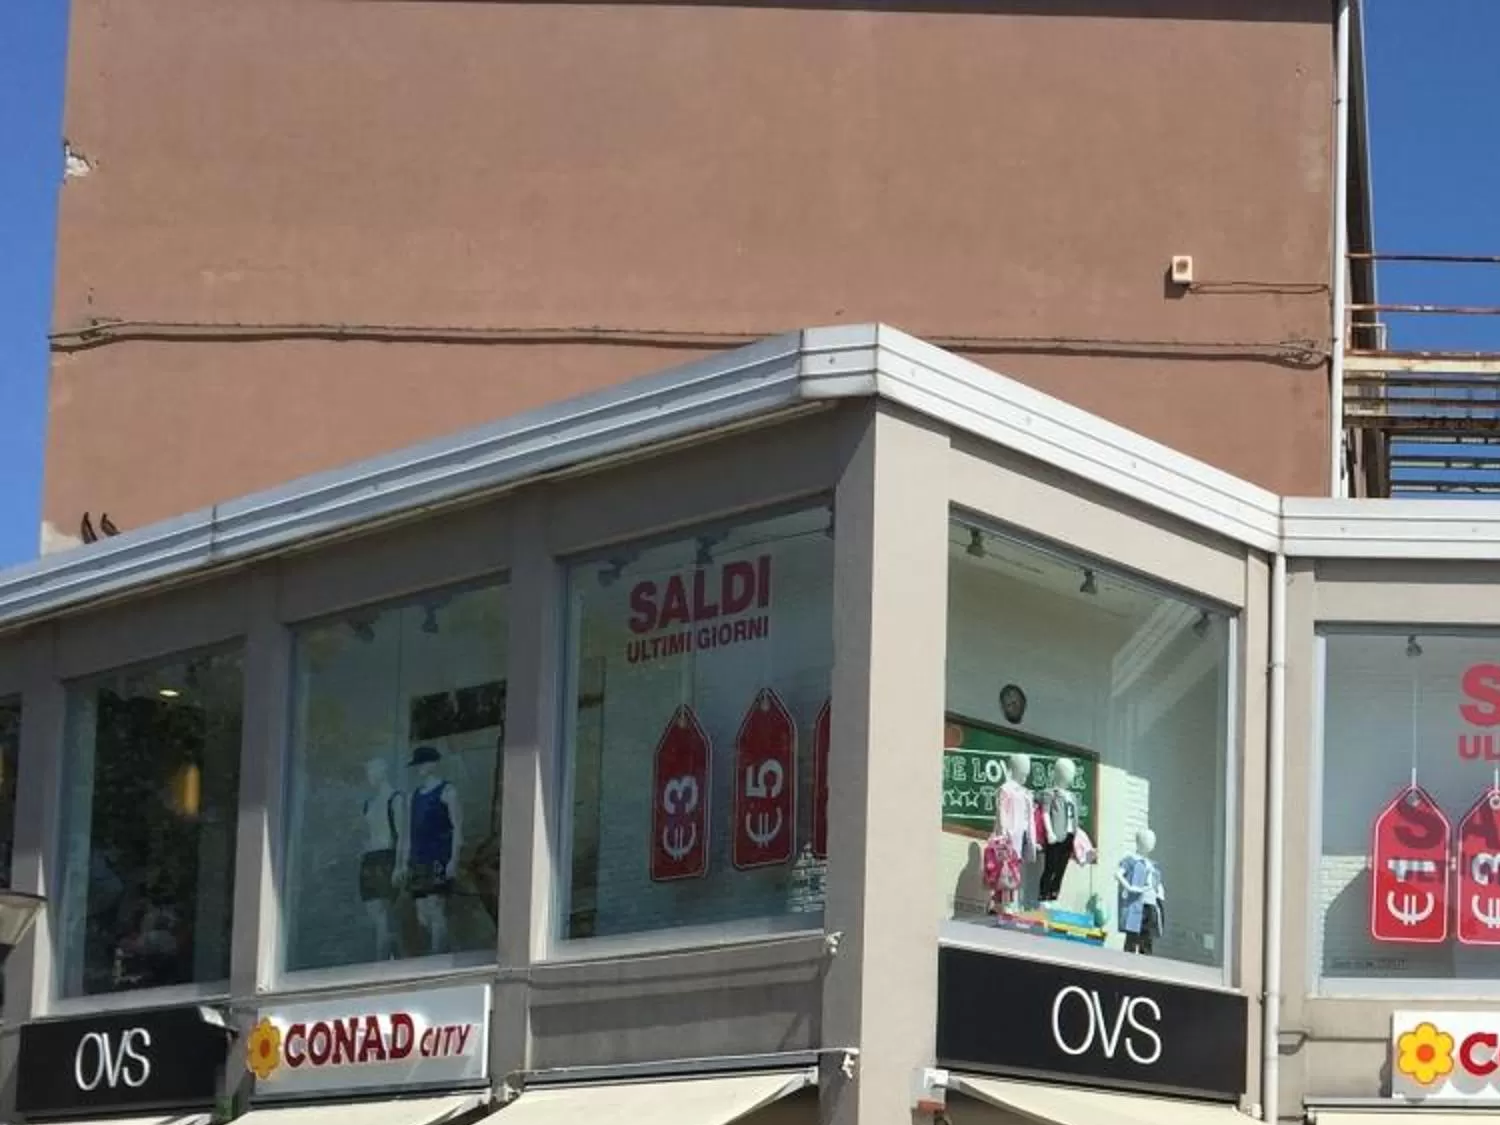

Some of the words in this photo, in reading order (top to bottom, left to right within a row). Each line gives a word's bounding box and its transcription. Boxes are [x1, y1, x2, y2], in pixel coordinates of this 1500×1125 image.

[629, 555, 771, 634] SALDI
[627, 632, 692, 664] ULTIMI
[696, 616, 769, 650] GIORNI
[283, 1012, 415, 1068] CONAD
[419, 1024, 471, 1058] CITY
[1051, 985, 1162, 1065] OVS
[75, 1027, 151, 1091] OVS
